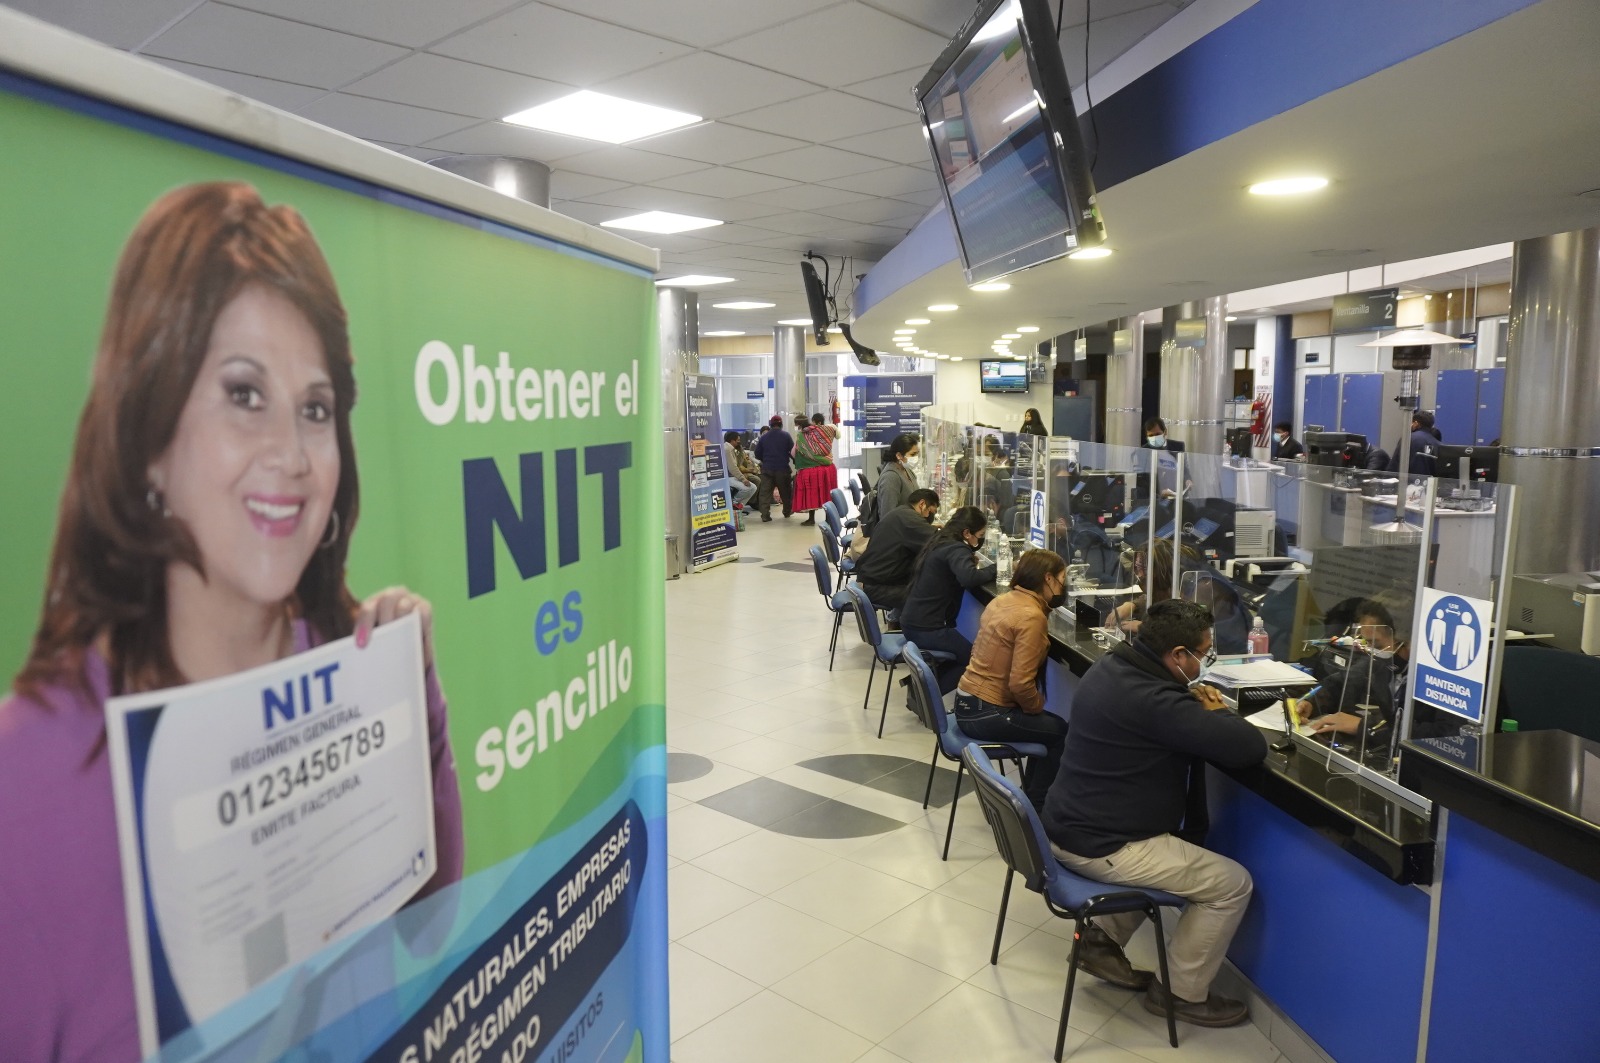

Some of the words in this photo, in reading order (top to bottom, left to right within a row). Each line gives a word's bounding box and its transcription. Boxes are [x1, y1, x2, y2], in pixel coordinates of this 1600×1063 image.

[1336, 304, 1370, 316] Ventanilla
[1385, 303, 1393, 319] 2
[414, 340, 606, 426] Obtener
[615, 359, 638, 417] el
[462, 441, 632, 600] NIT
[534, 590, 583, 656] es
[262, 661, 340, 730] NIT
[475, 639, 633, 792] sencillo
[1425, 674, 1471, 698] MANTENGA
[1425, 687, 1468, 710] DISTANCIA
[302, 706, 362, 743] GENERAL
[218, 720, 385, 827] 0123456789
[251, 808, 297, 846] EMITE
[301, 775, 361, 816] FACTURA
[424, 906, 553, 1062] NATURALES,
[557, 818, 631, 919] EMPRESAS
[549, 859, 631, 971] TRIBUTARIO
